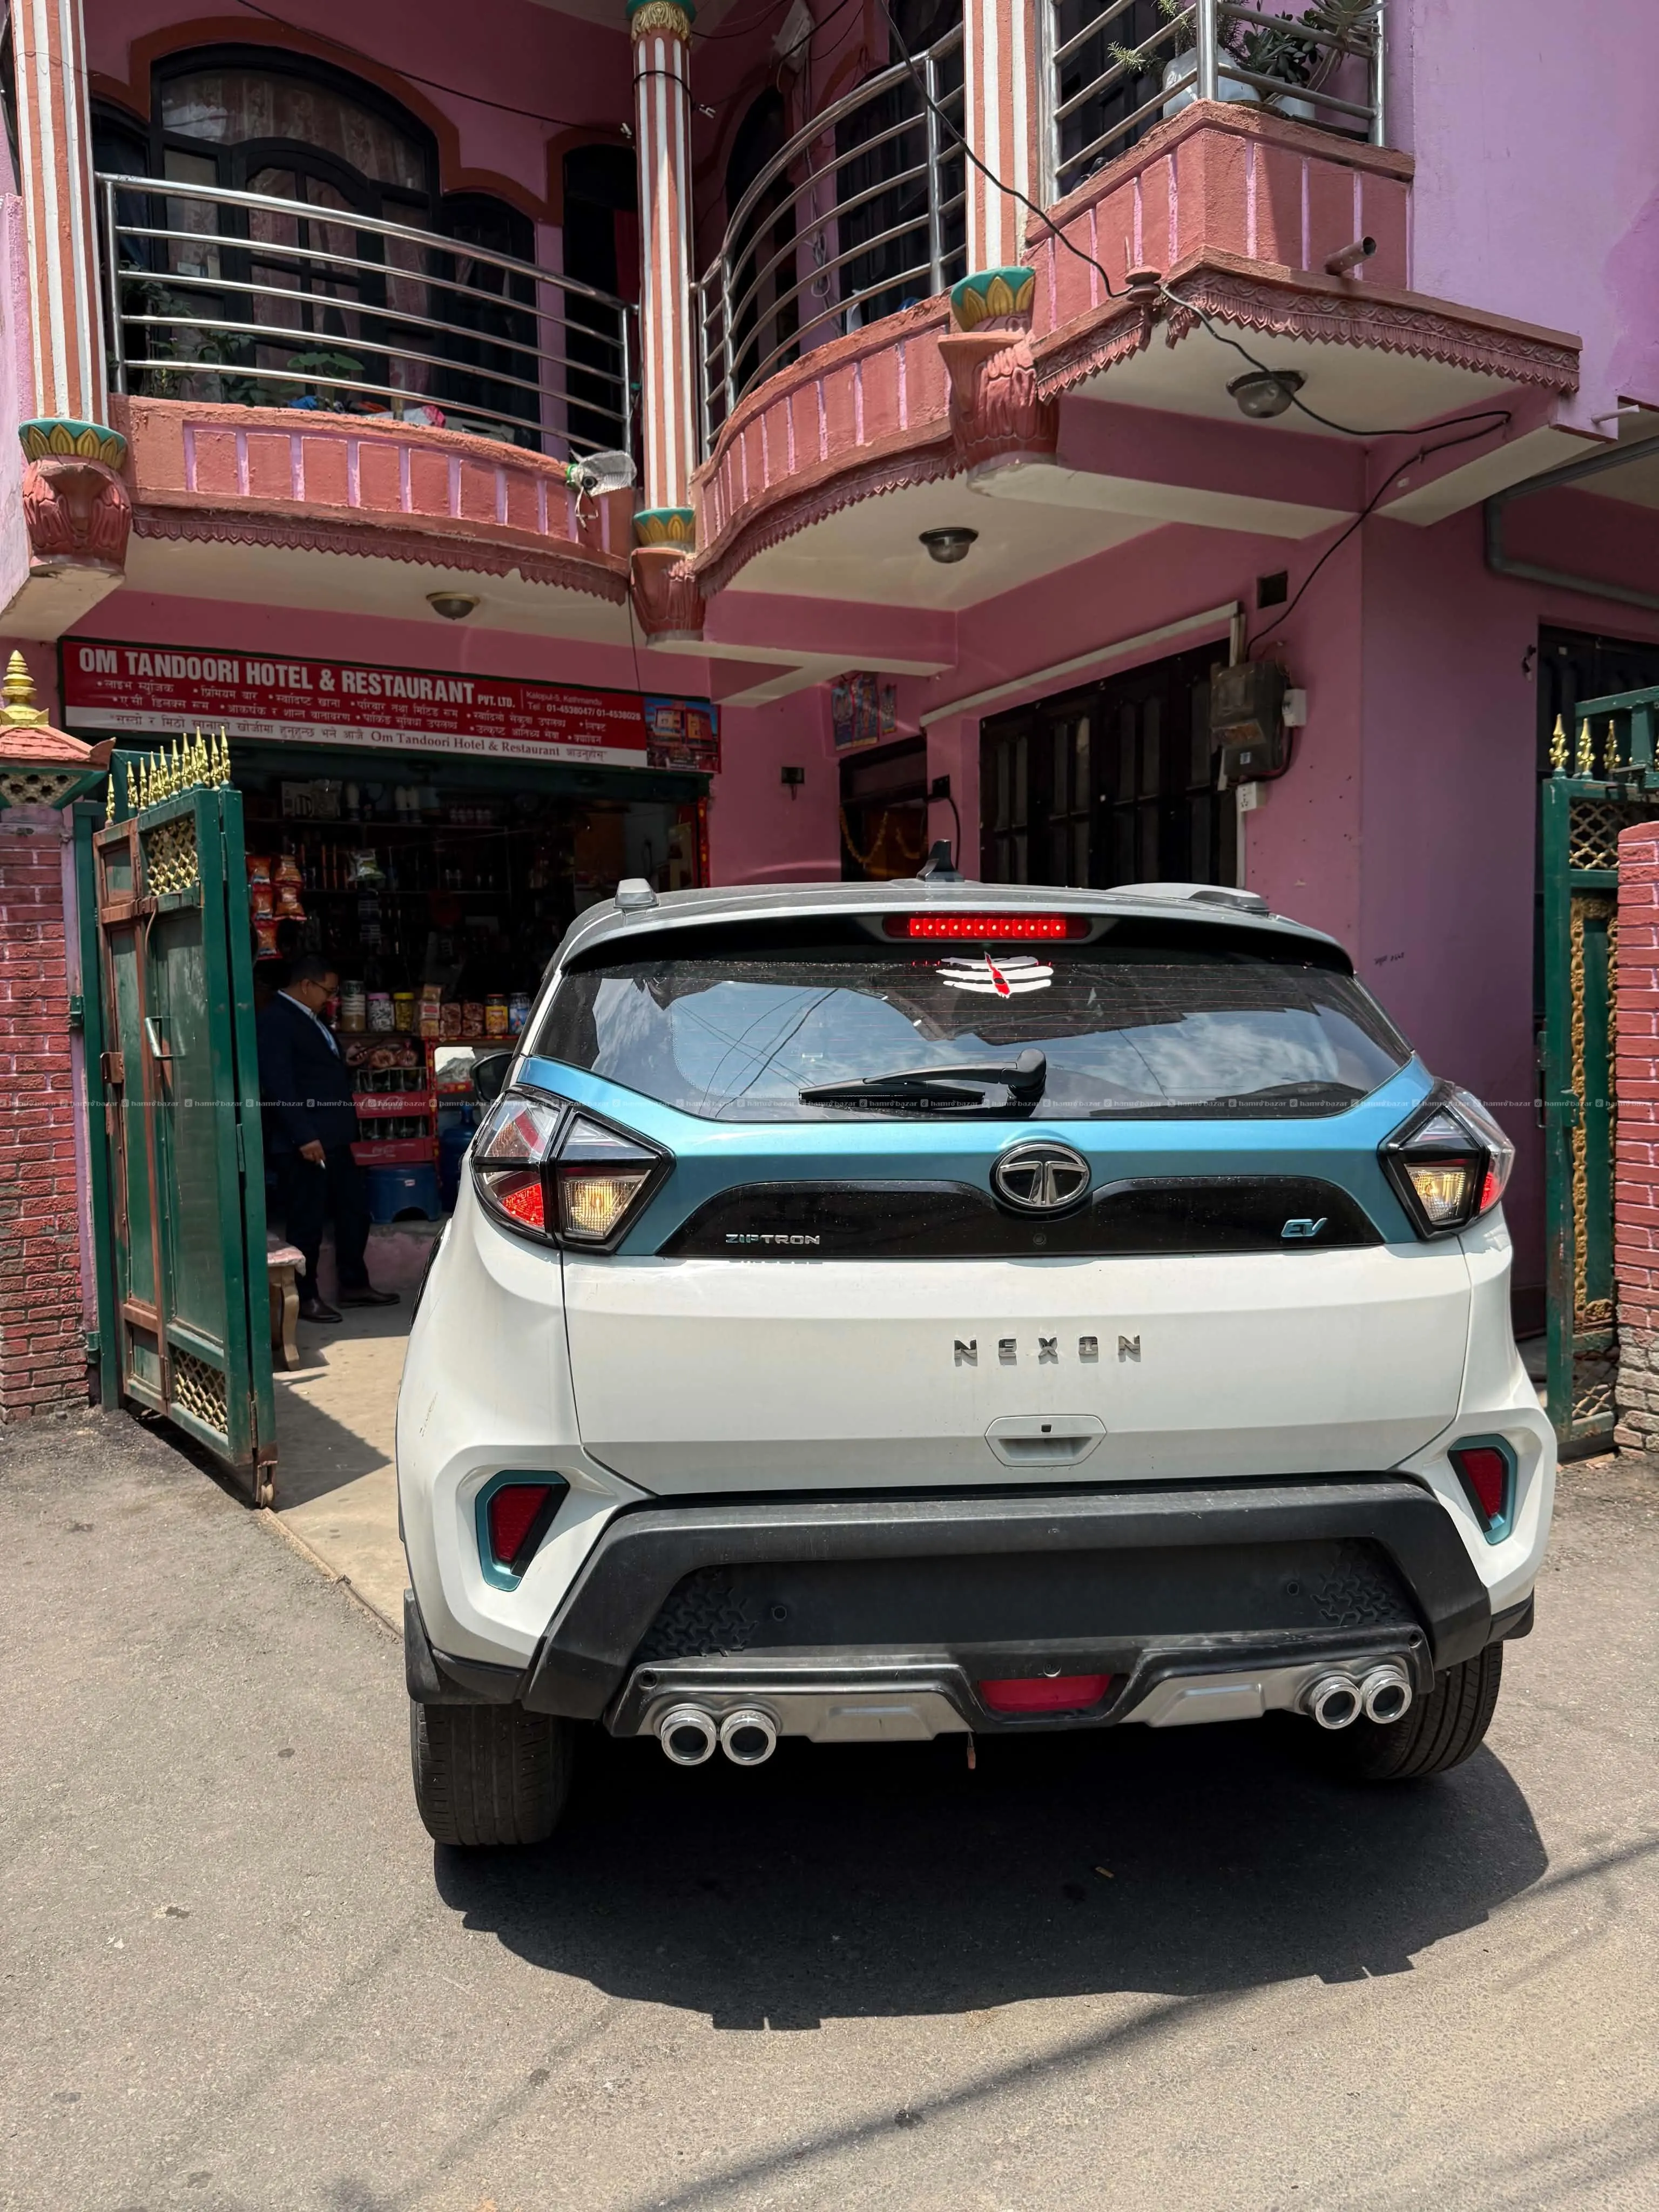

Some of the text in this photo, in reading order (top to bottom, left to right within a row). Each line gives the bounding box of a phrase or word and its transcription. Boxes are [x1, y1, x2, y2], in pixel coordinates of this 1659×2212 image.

[79, 648, 516, 709] OM TANDOORI HOTEL & RESTAURANT PVT. LTD.
[372, 731, 394, 744] Om
[396, 733, 450, 748] Tandoori
[454, 736, 485, 750] Hotel
[488, 740, 498, 752] &
[502, 741, 560, 757] Restaurant
[725, 1234, 820, 1245] ZIPTRON
[1280, 1217, 1328, 1238] EV
[954, 1335, 1141, 1359] NEXON
